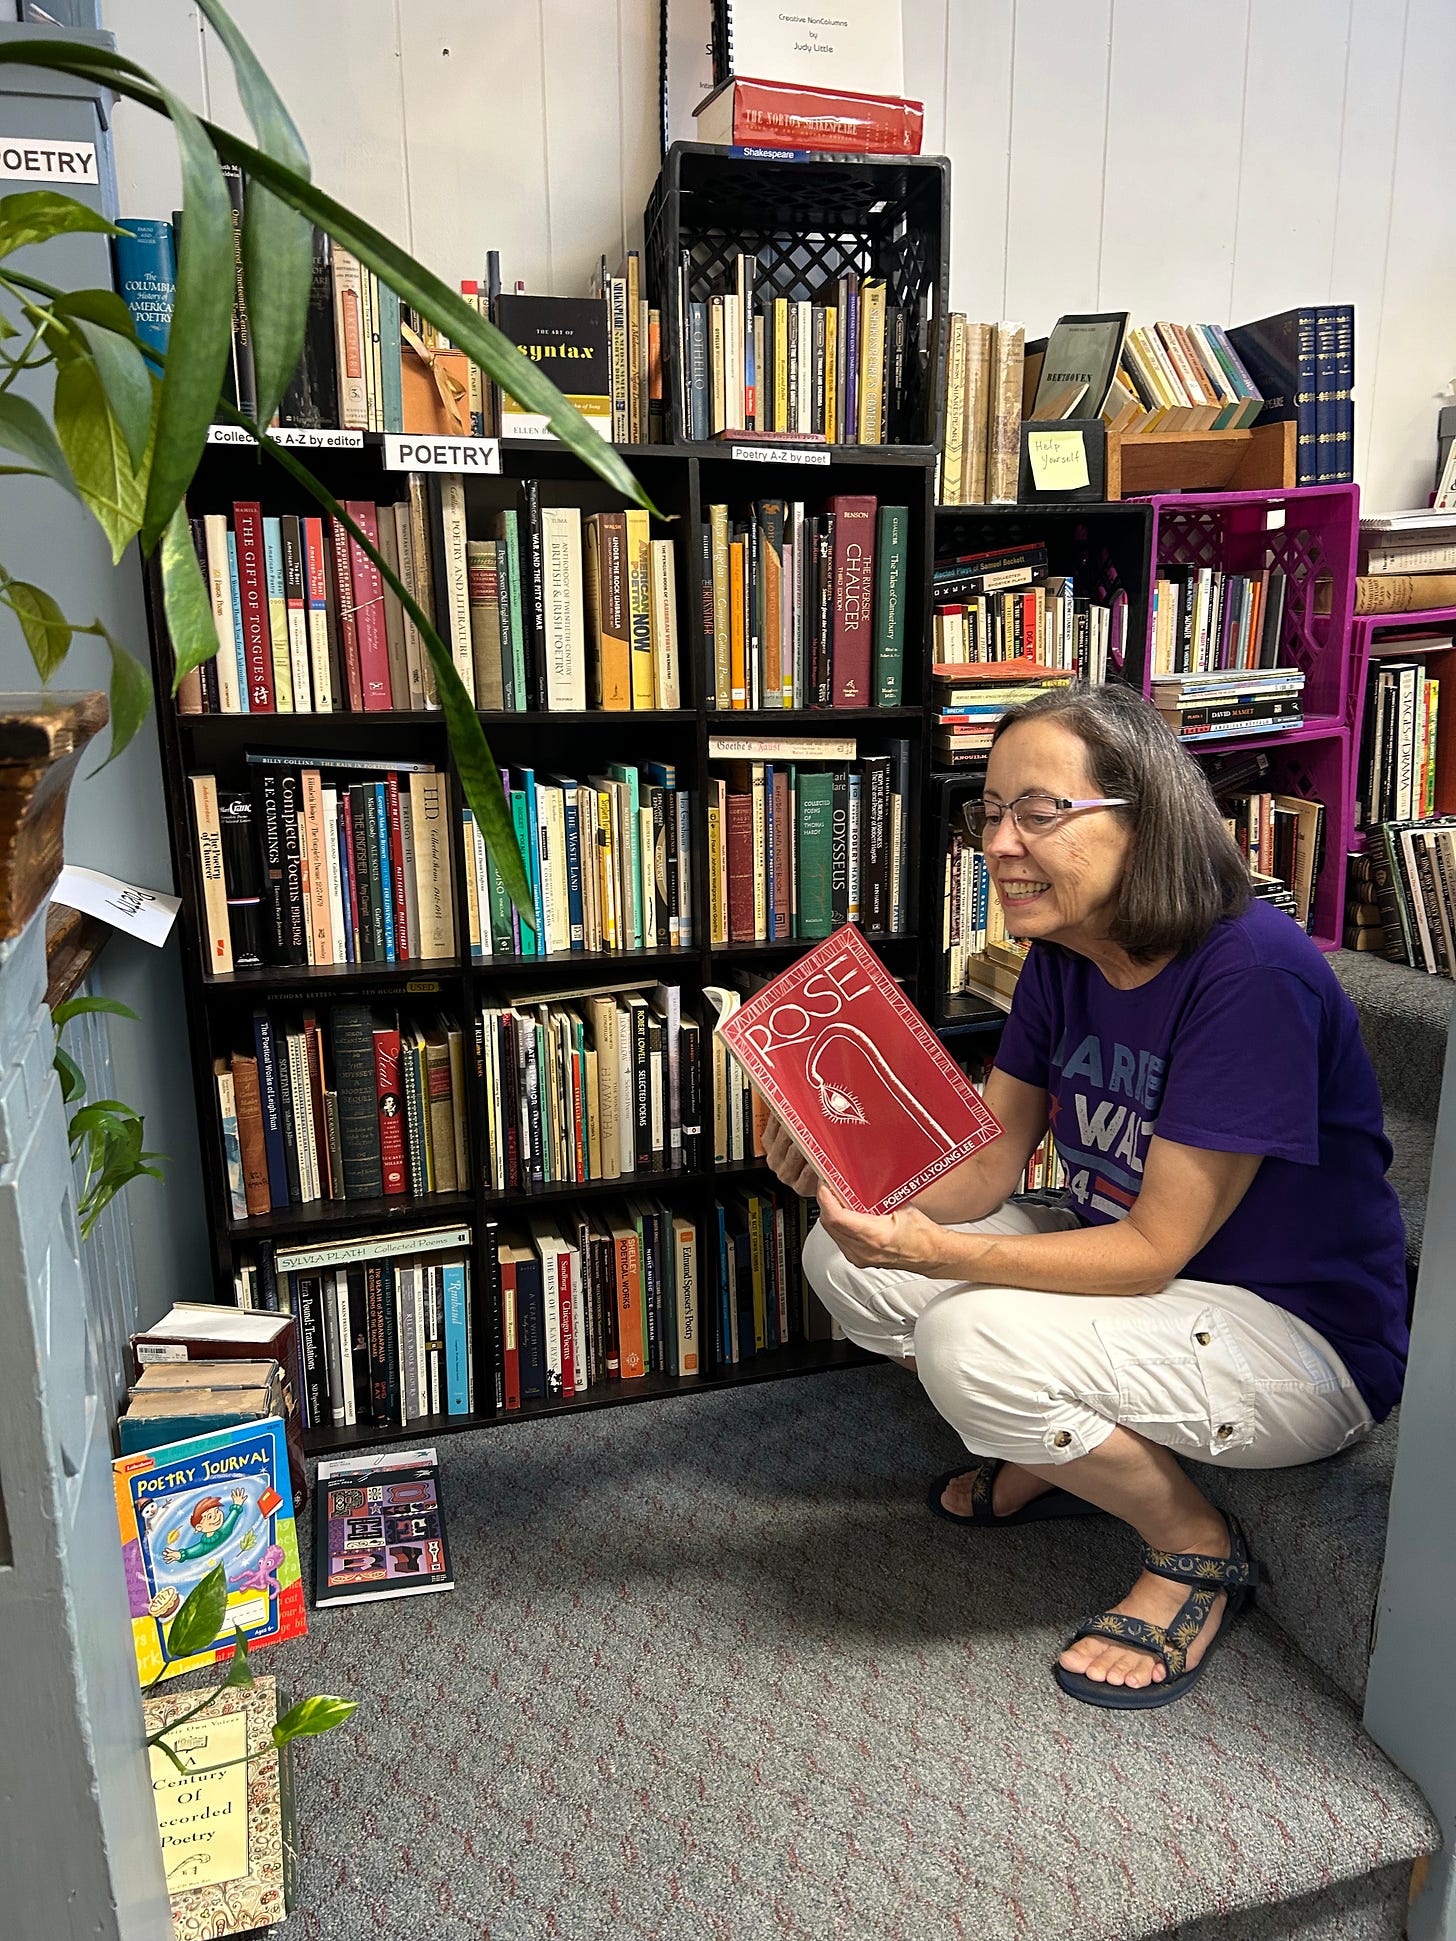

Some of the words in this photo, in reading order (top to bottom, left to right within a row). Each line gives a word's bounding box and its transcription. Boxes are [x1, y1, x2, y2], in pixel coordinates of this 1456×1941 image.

[779, 14, 806, 24] Creative
[808, 17, 848, 26] NonColumns
[794, 43, 811, 52] Judy
[814, 44, 833, 53] Little
[809, 31, 818, 39] by
[746, 110, 764, 122] THE
[767, 113, 800, 126] NORTON
[0, 150, 93, 173] OETRY
[744, 148, 794, 159] Shakespeare
[125, 281, 176, 292] COLUMBIA
[144, 272, 157, 281] The
[129, 302, 175, 312] AMERICA
[136, 312, 173, 322] POETRY
[613, 283, 625, 329] SHAKESPEARE
[517, 343, 594, 361] syntax
[693, 331, 704, 390] OTHELLO
[867, 308, 880, 388] SHAKESPEARE'S
[1046, 372, 1093, 383] BEETHOVEN
[866, 392, 879, 443] COMEDIES
[951, 384, 960, 443] SHAKESPEARE
[286, 435, 306, 444] A-Z
[310, 435, 323, 447] by
[1036, 439, 1061, 452] Help
[400, 445, 493, 466] POETRY
[736, 448, 767, 461] Poetry
[770, 450, 787, 461] A-Z
[790, 452, 802, 463] by
[805, 455, 826, 464] poet
[243, 518, 253, 546] THE
[452, 521, 462, 561] POETRY
[245, 552, 256, 587] GIFT
[552, 543, 560, 587] BRITISH
[863, 556, 871, 574] THE
[980, 561, 1001, 570] Samuel
[1003, 556, 1025, 565] Beckett
[455, 566, 463, 591] AND
[631, 561, 639, 613] POETRY
[638, 540, 649, 613] AMERICAN
[845, 544, 861, 632] CHAUCER
[248, 591, 258, 609] OF
[535, 602, 542, 612] OF
[553, 590, 561, 598] &
[861, 577, 870, 621] RIVERSIDE
[456, 594, 467, 658] LITERATURE
[553, 600, 562, 629] IRISH
[633, 614, 650, 653] NOW
[250, 615, 264, 682] TONGUES
[554, 635, 564, 676] POETRY
[1402, 691, 1412, 733] STAGES
[717, 741, 752, 751] Goethe's
[758, 741, 780, 752] Faust
[1402, 734, 1411, 742] of
[1400, 743, 1412, 791] DRAMA
[265, 777, 275, 788] E.
[266, 789, 276, 799] E.
[282, 777, 298, 849] Complete
[568, 809, 577, 829] THE
[202, 832, 210, 841] of
[210, 832, 220, 849] The
[266, 801, 279, 863] CUMMINGS
[204, 843, 214, 880] Chaucer
[832, 809, 845, 890] ODYSSEUS
[211, 850, 221, 879] Poetry
[287, 855, 302, 901] Poems
[571, 867, 579, 891] LAND
[290, 906, 302, 946] 1913-1962
[744, 953, 873, 1069] ROSE
[261, 1023, 269, 1035] The
[262, 1037, 271, 1063] Poetical
[638, 1038, 646, 1064] LOWELL
[264, 1065, 272, 1085] Works
[378, 1042, 398, 1088] Keats
[279, 1059, 290, 1104] SOLITAIRE
[638, 1070, 646, 1102] SELECTED
[267, 1094, 276, 1113] Leigh
[601, 1068, 613, 1139] HIAWATHA
[639, 1103, 647, 1126] POEMS
[882, 1186, 910, 1209] POEMS
[909, 1174, 921, 1191] BY
[920, 1147, 960, 1183] LI-YOUNG
[958, 1139, 976, 1154] LEE
[282, 1255, 325, 1267] SYLVIA
[328, 1248, 366, 1261] PLATH
[375, 1243, 416, 1253] Collected
[419, 1238, 447, 1248] Poems
[620, 1240, 628, 1279] POETICAL
[683, 1247, 692, 1278] Edmund
[301, 1281, 311, 1297] Ezra
[561, 1261, 569, 1291] Sandburg
[450, 1280, 462, 1324] Rimbaud
[683, 1280, 692, 1314] Spenser's
[302, 1299, 313, 1324] Pound:
[562, 1301, 570, 1332] Chicago
[684, 1316, 694, 1340] Poetry
[304, 1326, 315, 1370] Translations
[564, 1334, 572, 1359] Poems
[137, 1468, 196, 1497] POETRY
[203, 1448, 270, 1481] JOURNAL
[211, 1718, 239, 1726] Voices
[152, 1771, 227, 1791] Century
[178, 1789, 202, 1804] Of
[160, 1802, 232, 1828] ecorded
[161, 1831, 216, 1848] Poetry
